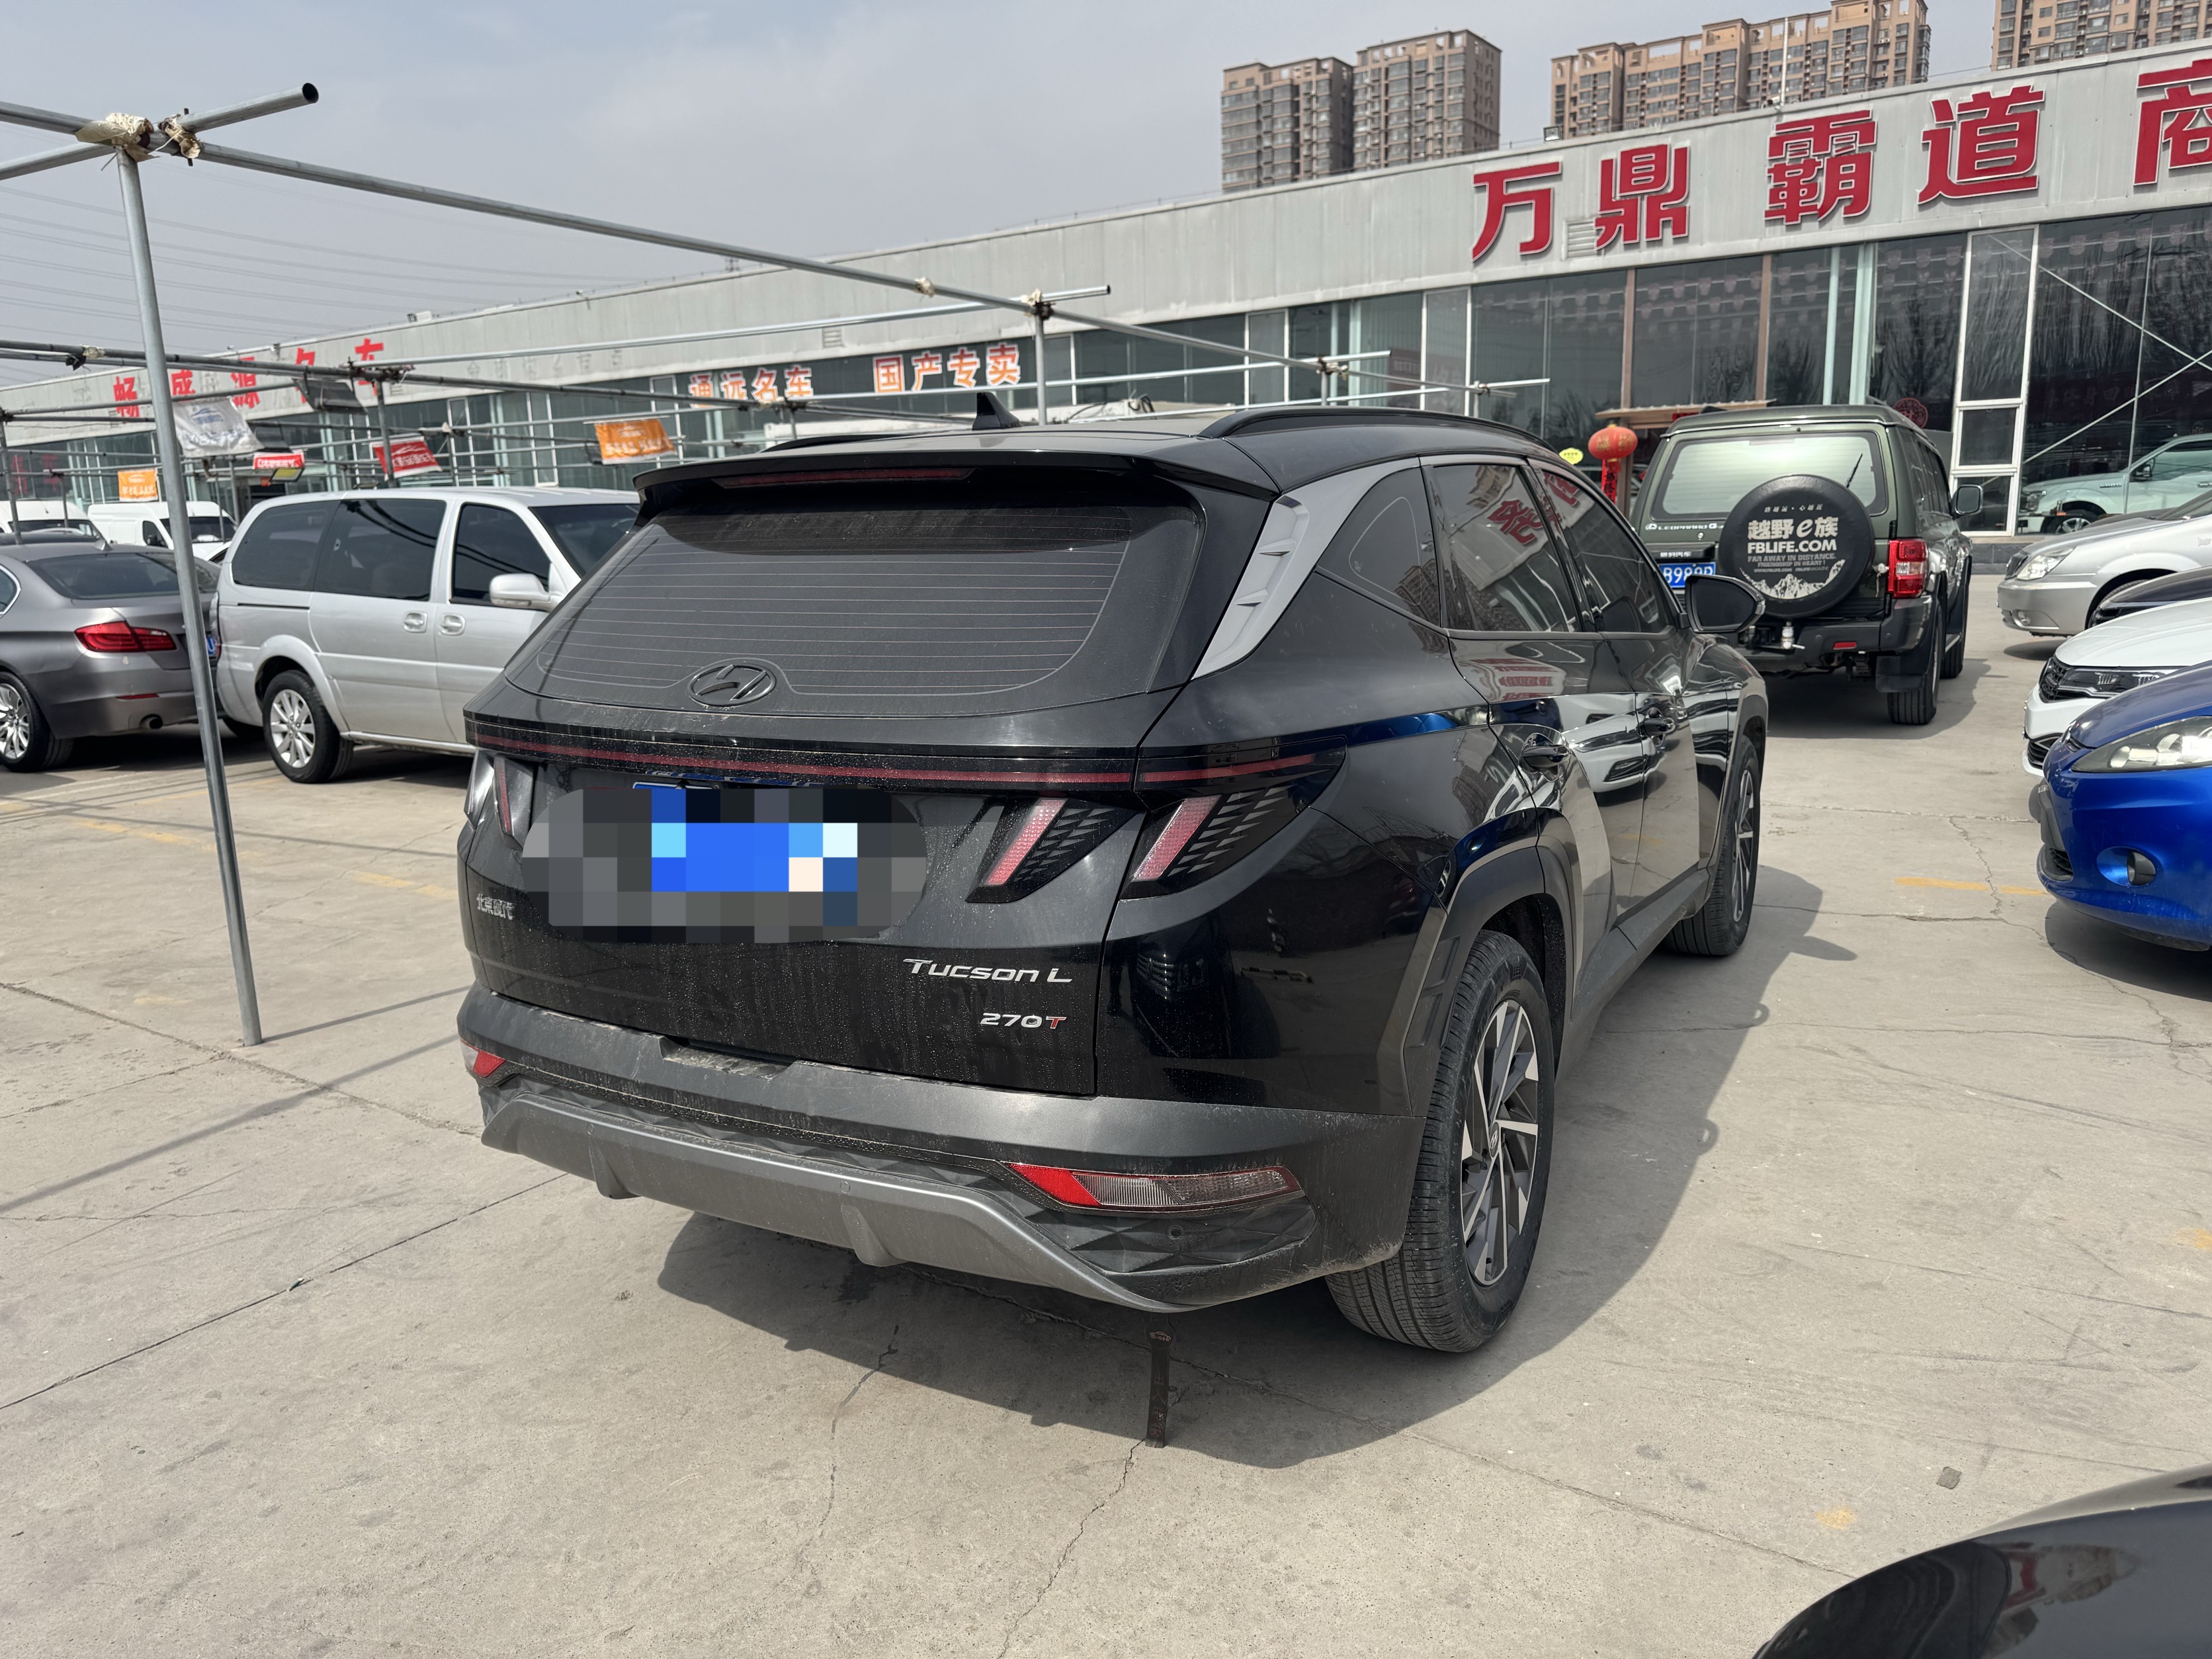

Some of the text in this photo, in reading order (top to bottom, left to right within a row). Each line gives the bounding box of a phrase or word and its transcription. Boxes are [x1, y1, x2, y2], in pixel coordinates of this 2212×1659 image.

[689, 343, 1020, 408] 通远名车 国产专卖
[1748, 516, 1839, 540] 越野e族
[1748, 539, 1837, 554] FBLIFE.COM
[1046, 968, 1074, 983] L
[980, 1012, 1067, 1029] 270T
